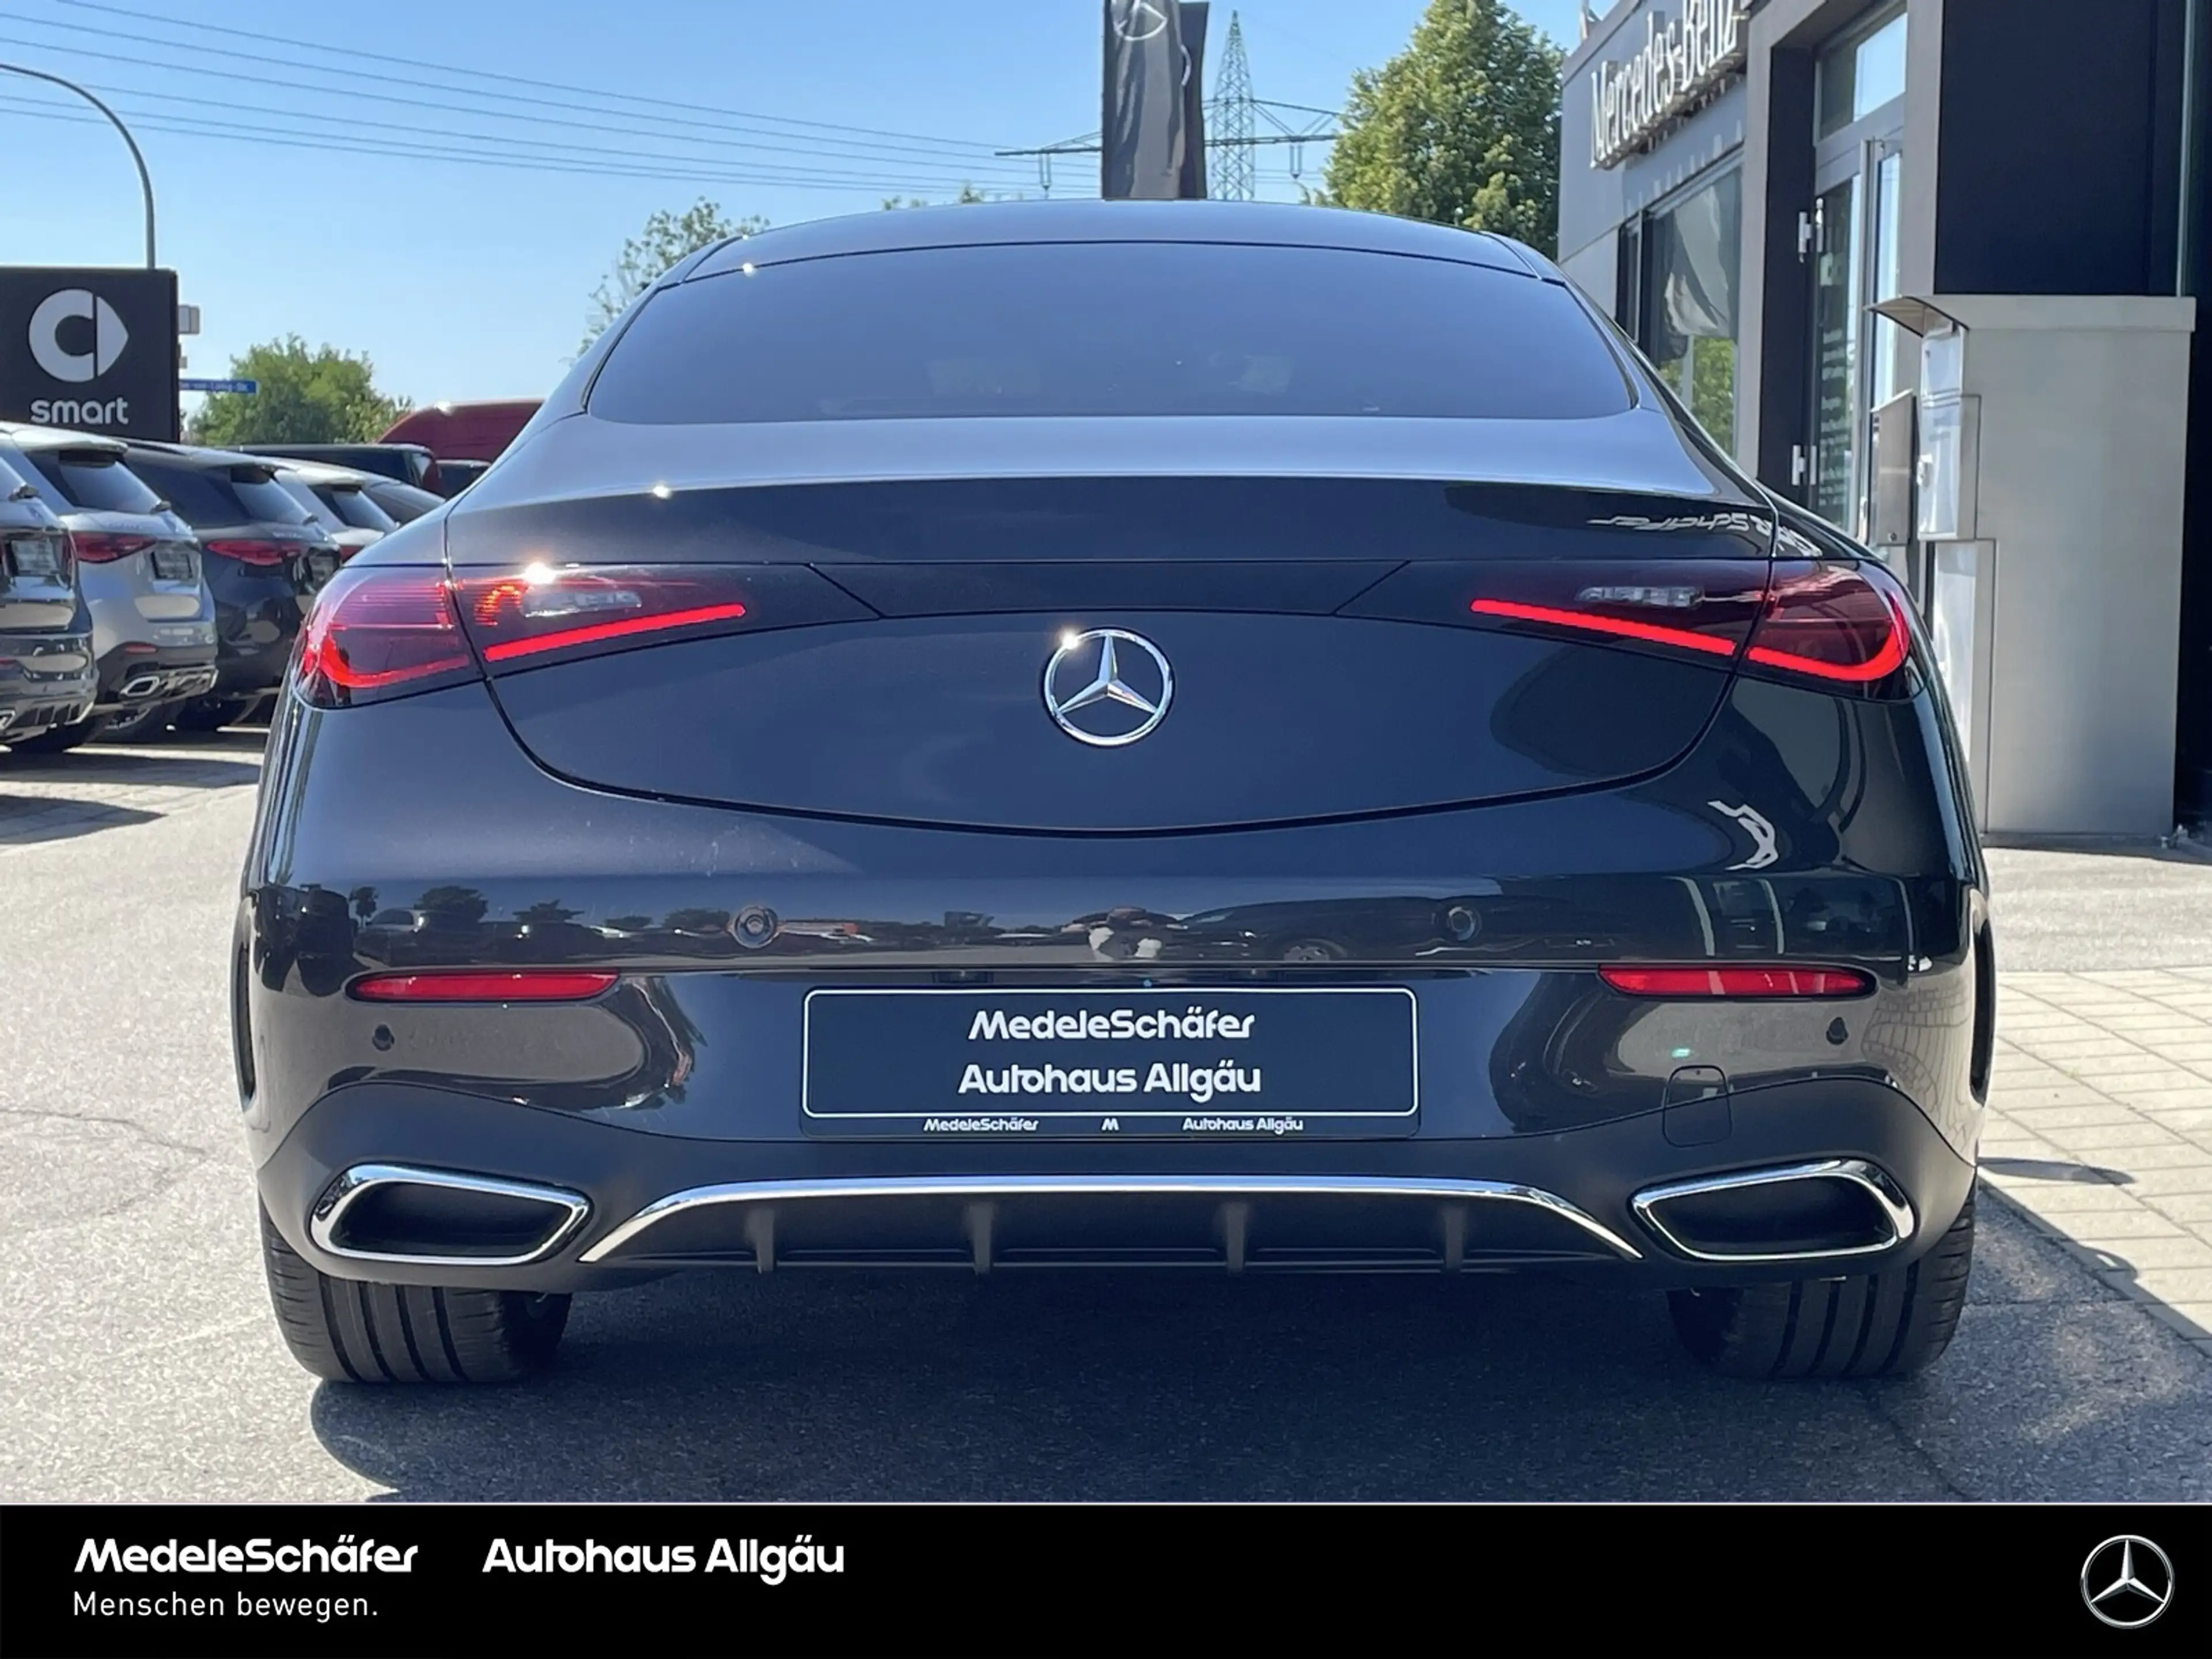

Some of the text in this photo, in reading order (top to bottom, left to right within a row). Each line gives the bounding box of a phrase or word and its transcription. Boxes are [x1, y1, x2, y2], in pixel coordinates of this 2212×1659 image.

[1589, 0, 1737, 168] Mercedes-Benz
[31, 397, 129, 425] smart
[968, 1006, 1255, 1040] MedeleSchäfer
[957, 1059, 1262, 1104] Autohaus Allgäu
[923, 1117, 1039, 1132] MedeleSchäfer
[1182, 1117, 1255, 1131] Autohaus
[1256, 1116, 1304, 1135] Allgäu
